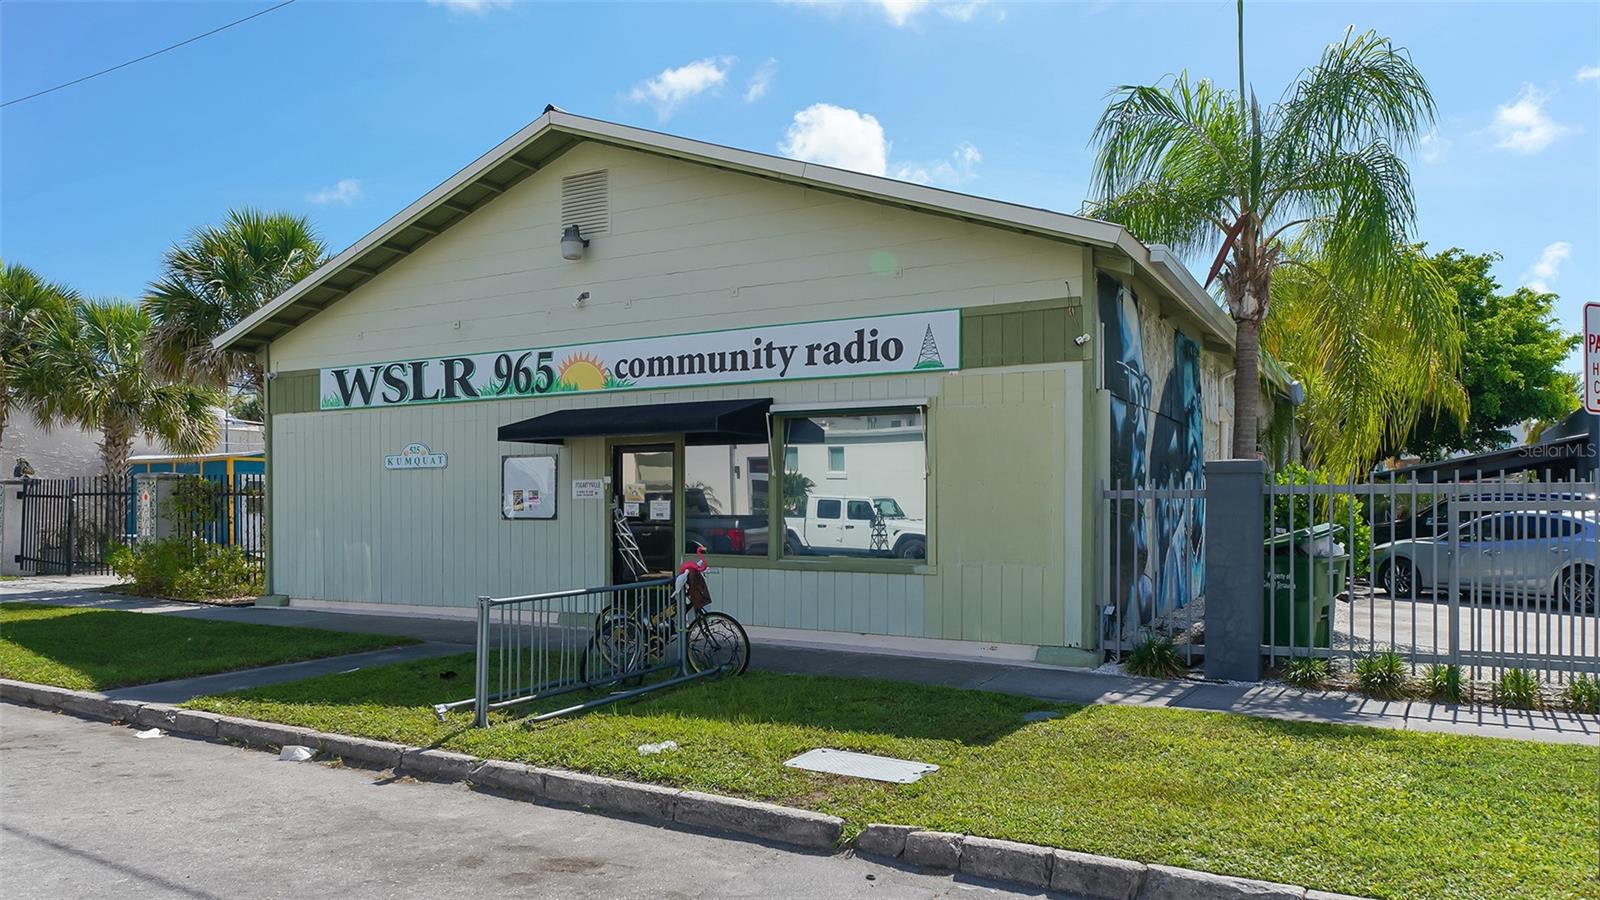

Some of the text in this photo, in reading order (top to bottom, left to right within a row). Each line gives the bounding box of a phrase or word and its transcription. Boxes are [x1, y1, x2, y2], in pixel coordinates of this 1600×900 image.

[331, 357, 480, 406] WSLR
[614, 337, 798, 378] community
[804, 328, 904, 366] radio
[409, 445, 421, 455] 525
[387, 456, 443, 467] KUMQUAT
